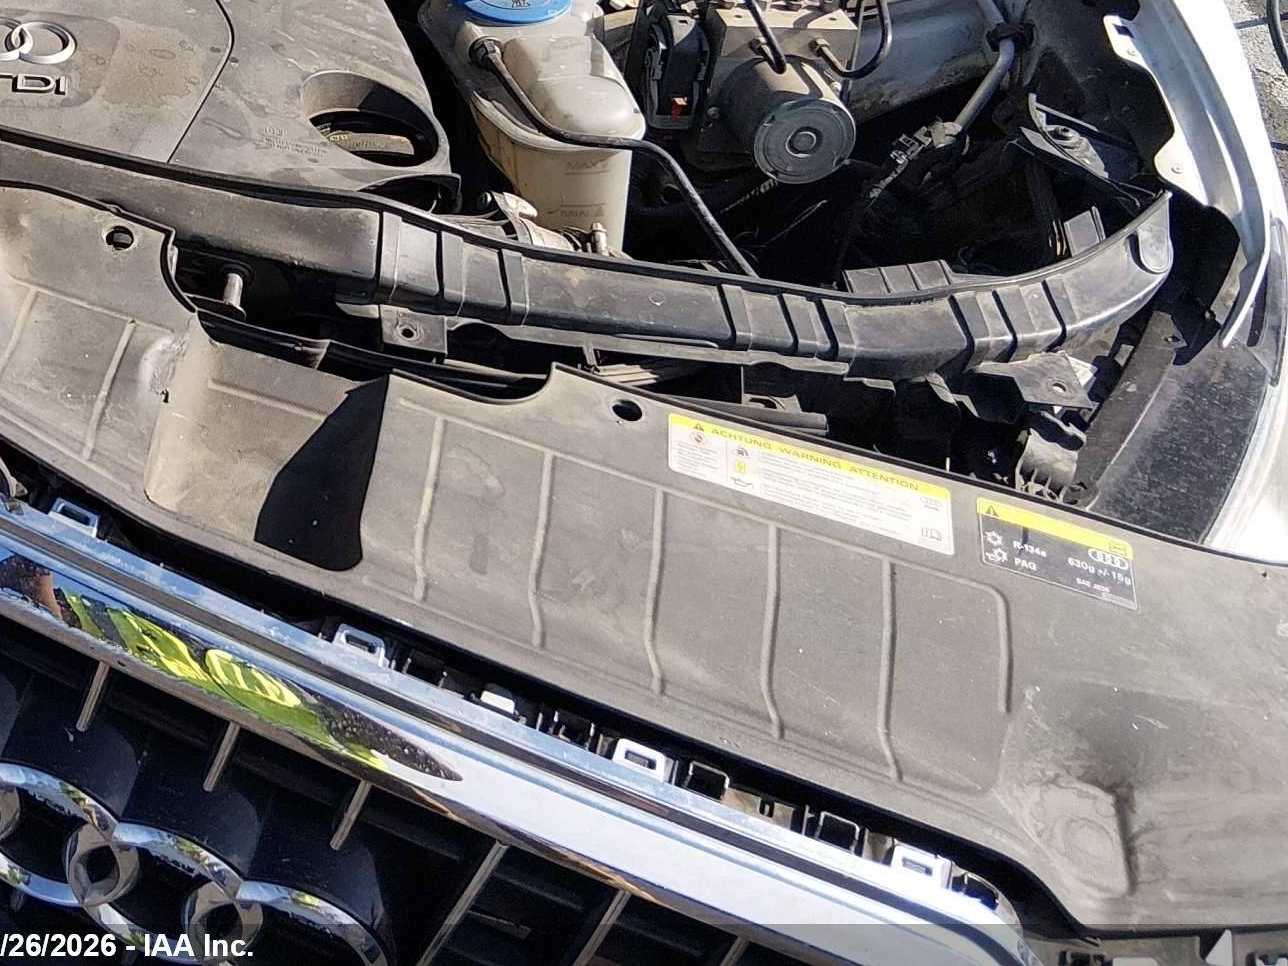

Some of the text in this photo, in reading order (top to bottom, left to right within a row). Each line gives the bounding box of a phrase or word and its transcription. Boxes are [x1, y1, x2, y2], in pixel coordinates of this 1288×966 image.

[710, 428, 920, 491] ACHTUNG WARNING ATTENTION
[1012, 540, 1048, 558] R-134a
[1014, 557, 1037, 571] PAG
